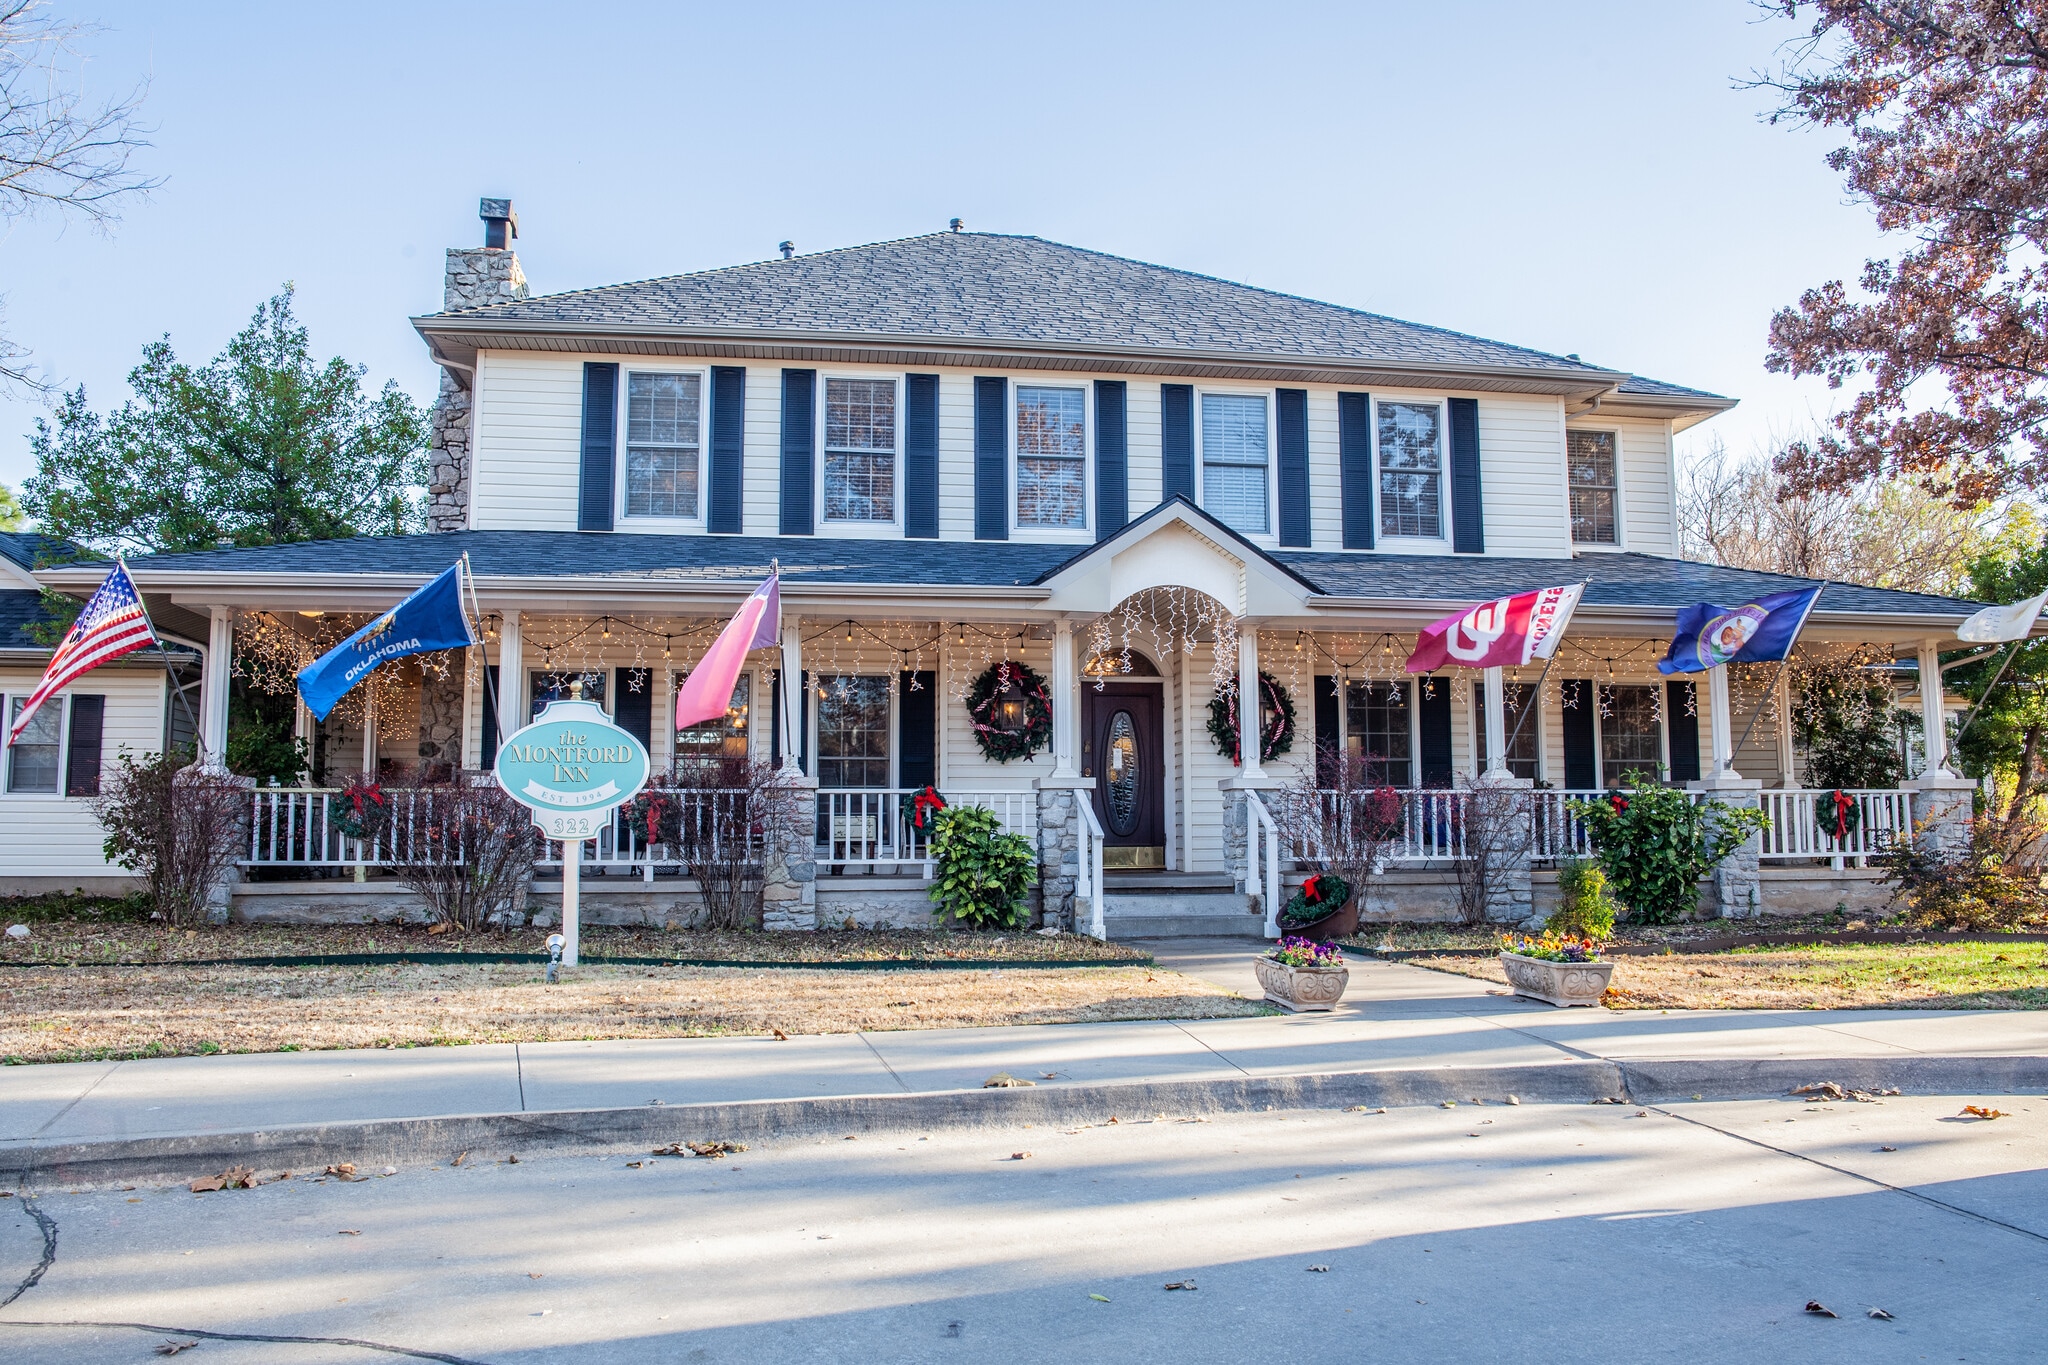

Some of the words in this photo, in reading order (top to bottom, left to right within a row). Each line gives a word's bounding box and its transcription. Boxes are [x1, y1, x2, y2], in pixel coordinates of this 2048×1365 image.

[344, 638, 421, 681] OKLAHOMA
[559, 730, 587, 746] the
[510, 744, 633, 764] MONTFORD
[552, 764, 591, 783] INN
[541, 791, 569, 804] EST.
[576, 791, 602, 804] 1994
[554, 818, 589, 834] 322
